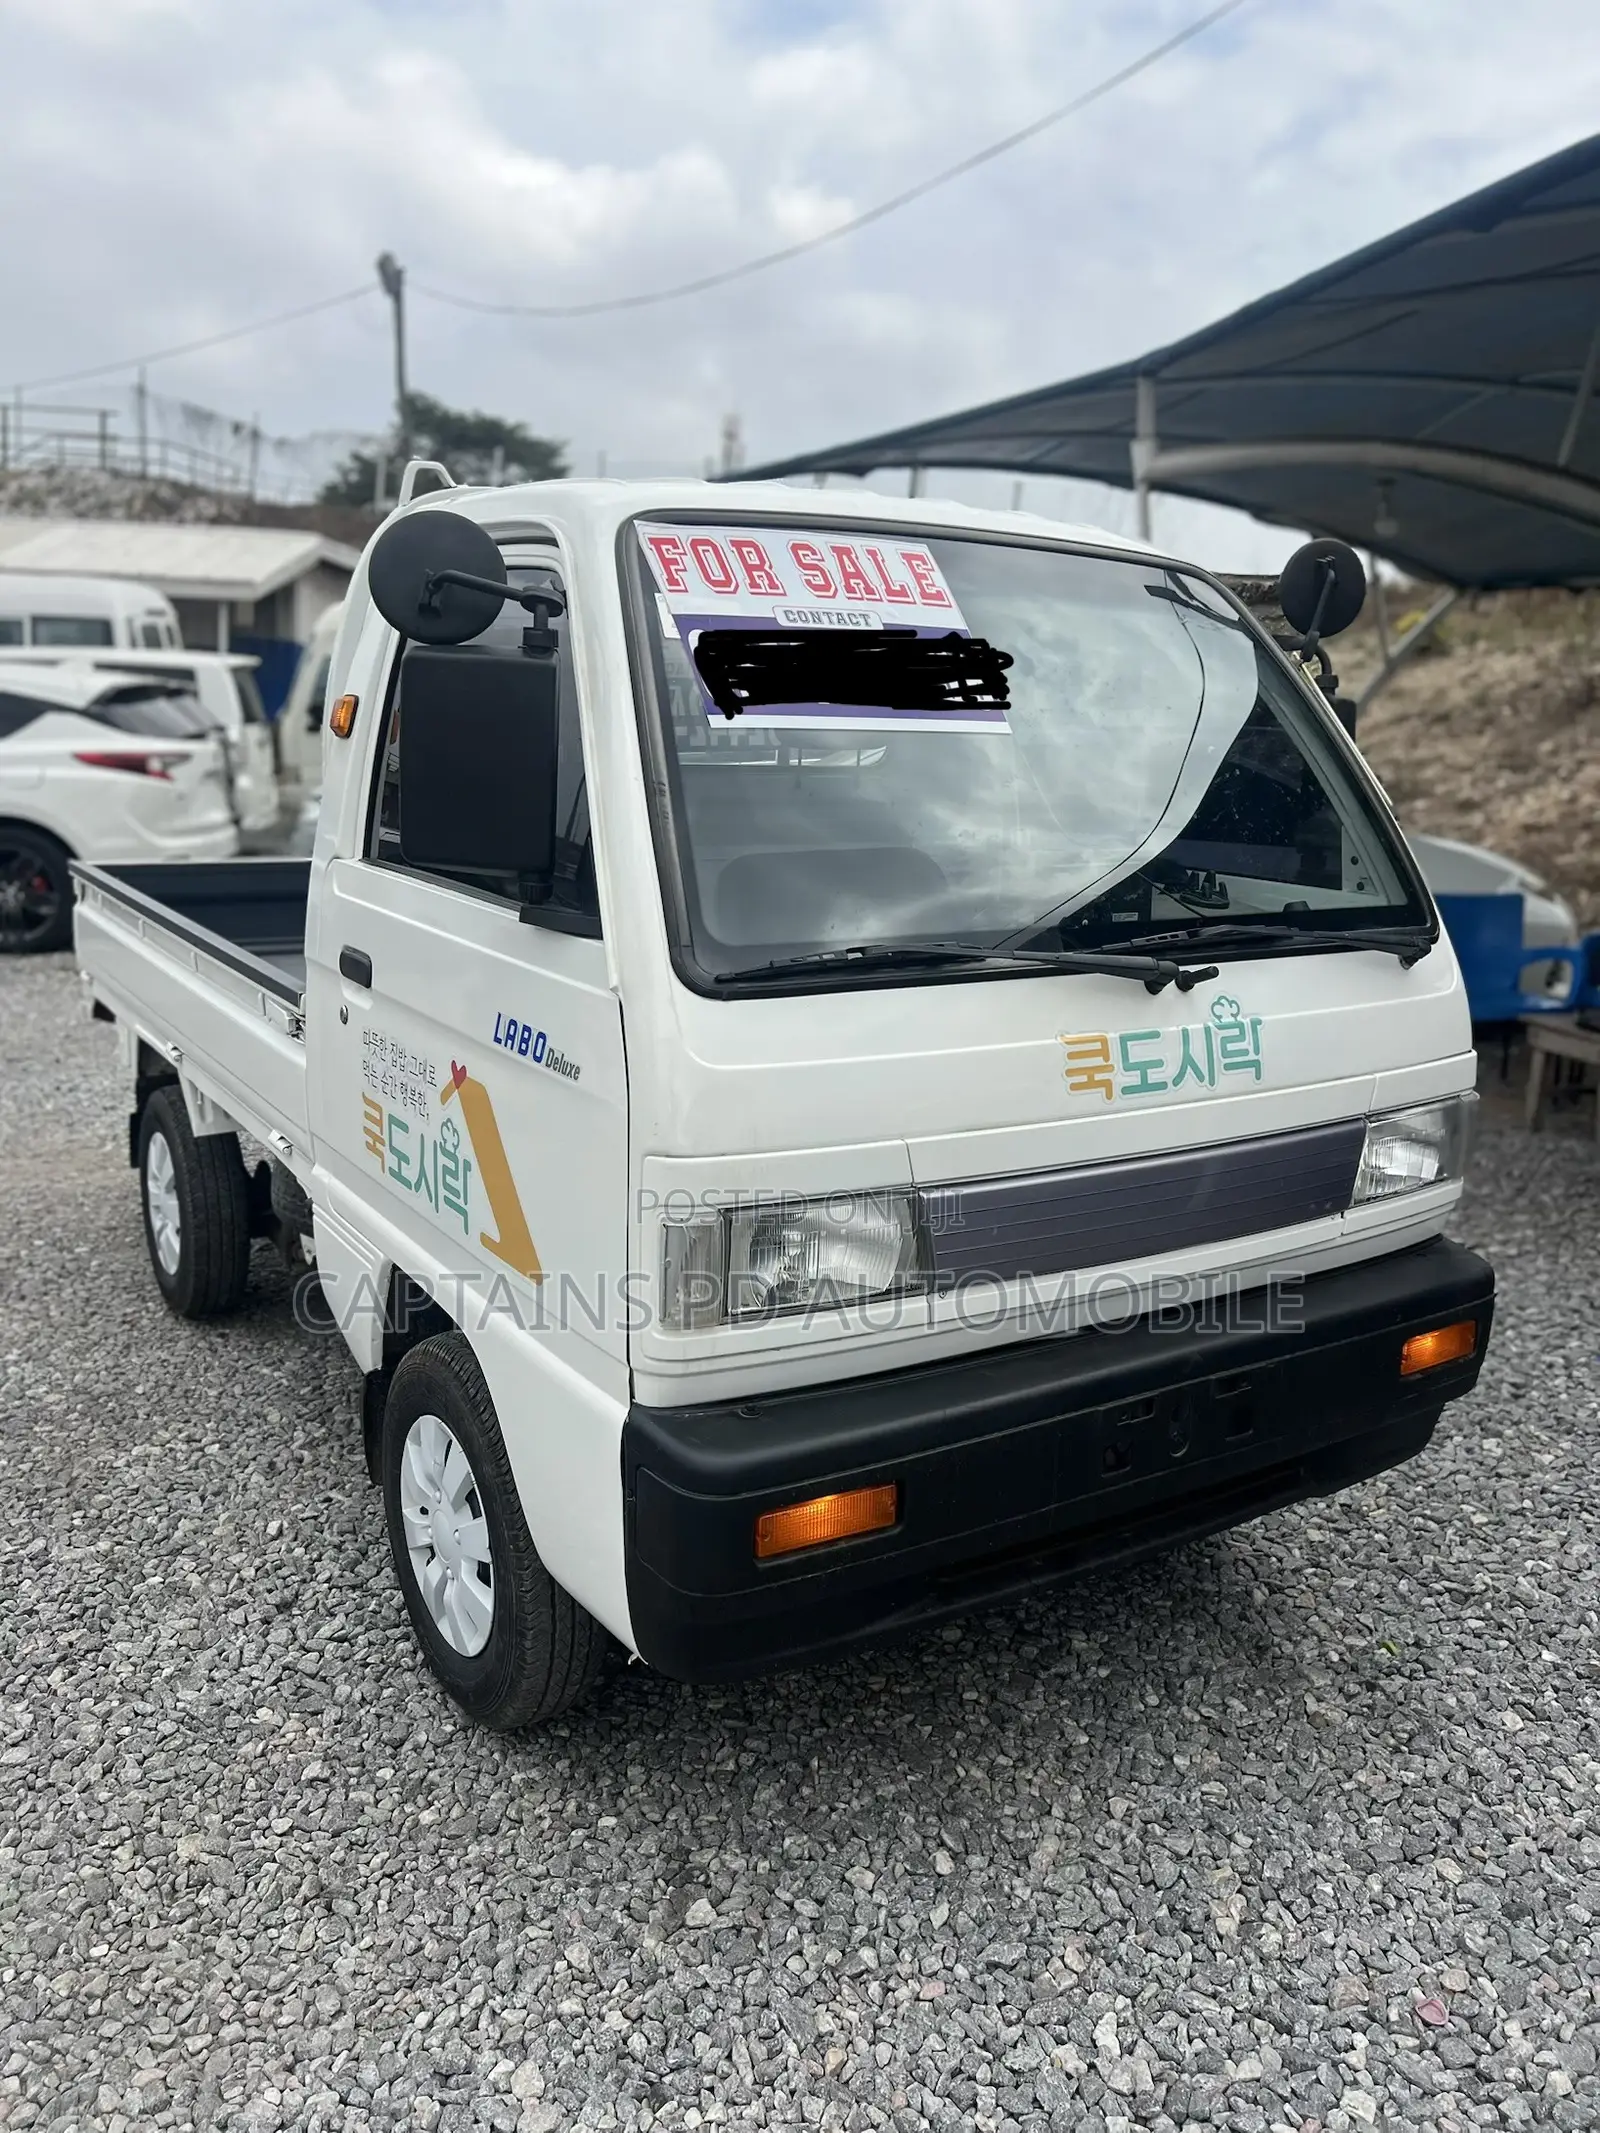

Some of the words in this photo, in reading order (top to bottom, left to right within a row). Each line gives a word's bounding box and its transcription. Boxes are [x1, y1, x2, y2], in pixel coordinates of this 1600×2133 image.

[648, 534, 787, 596] FOR
[787, 539, 953, 608] SALE
[783, 609, 872, 627] CONTACT
[493, 1011, 547, 1064] LABO
[545, 1046, 581, 1081] Deluxe
[1059, 1017, 1263, 1100] 쿡도시락
[362, 1091, 472, 1236] 쿡도시락
